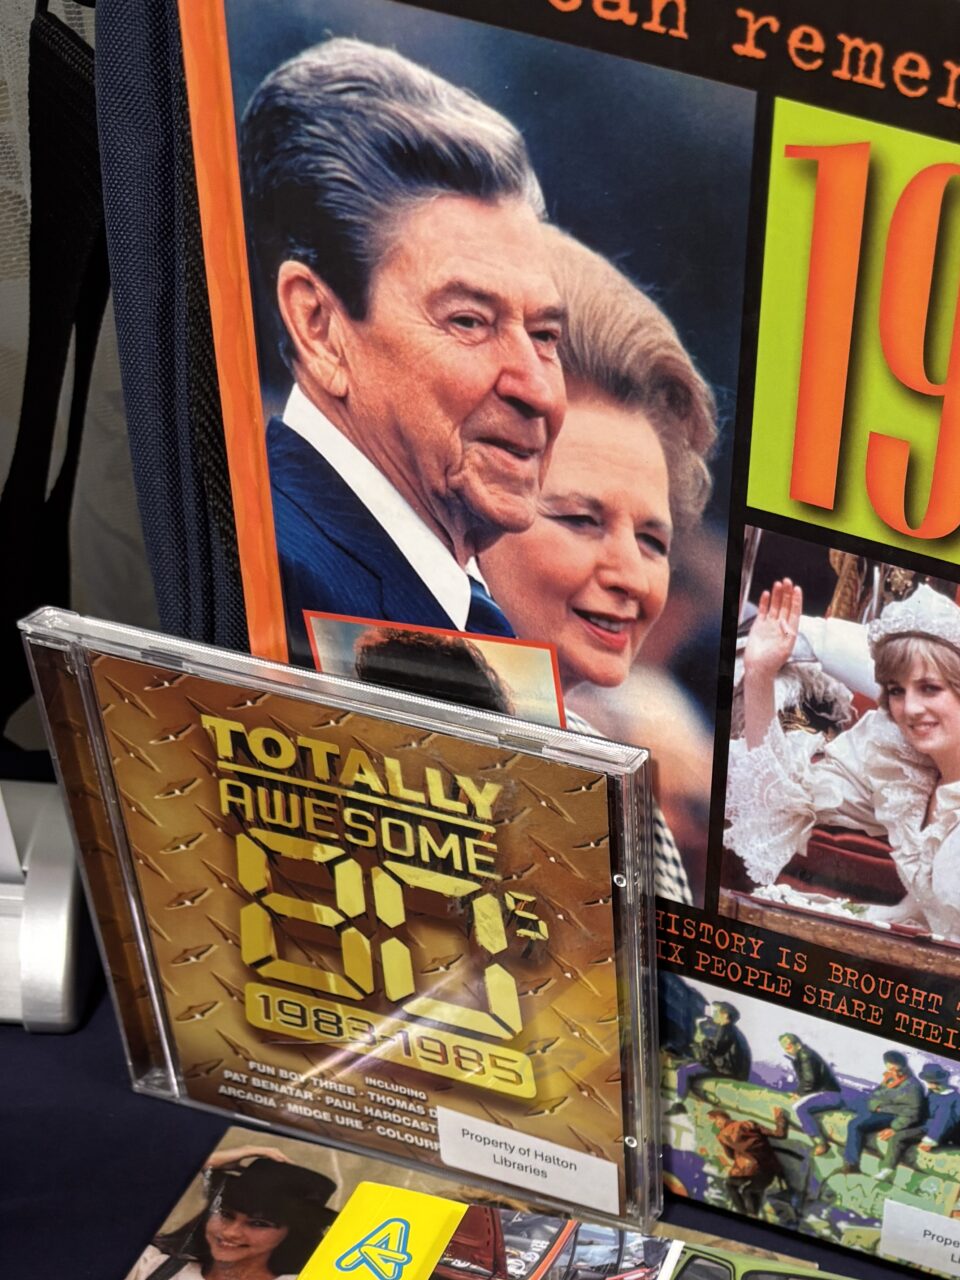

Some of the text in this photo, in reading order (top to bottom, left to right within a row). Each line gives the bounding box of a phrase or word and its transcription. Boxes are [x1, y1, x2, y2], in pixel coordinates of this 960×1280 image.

[549, 0, 688, 40] an
[201, 714, 503, 820] TOTALLY
[218, 778, 502, 881] AWESOME
[694, 950, 792, 998] PEOPLE
[802, 984, 884, 1026] SHARE
[777, 946, 808, 973] IS
[827, 961, 943, 1015] BROUGHT
[254, 992, 525, 1087] 1983-1985
[218, 1084, 277, 1108] ARCADIA
[287, 1103, 333, 1124] MIDGE
[335, 1114, 364, 1131] URE
[223, 1070, 249, 1084] PAT
[250, 1076, 314, 1101] BENATAR
[324, 1095, 360, 1113] PAUL
[248, 1061, 276, 1077] FUN
[278, 1067, 305, 1082] BOY
[310, 1074, 356, 1096] THREE
[367, 1090, 426, 1115] THOMAS
[364, 1076, 427, 1100] INCLUDING
[461, 1128, 578, 1172] Property of Halton
[492, 1154, 548, 1180] Libraries
